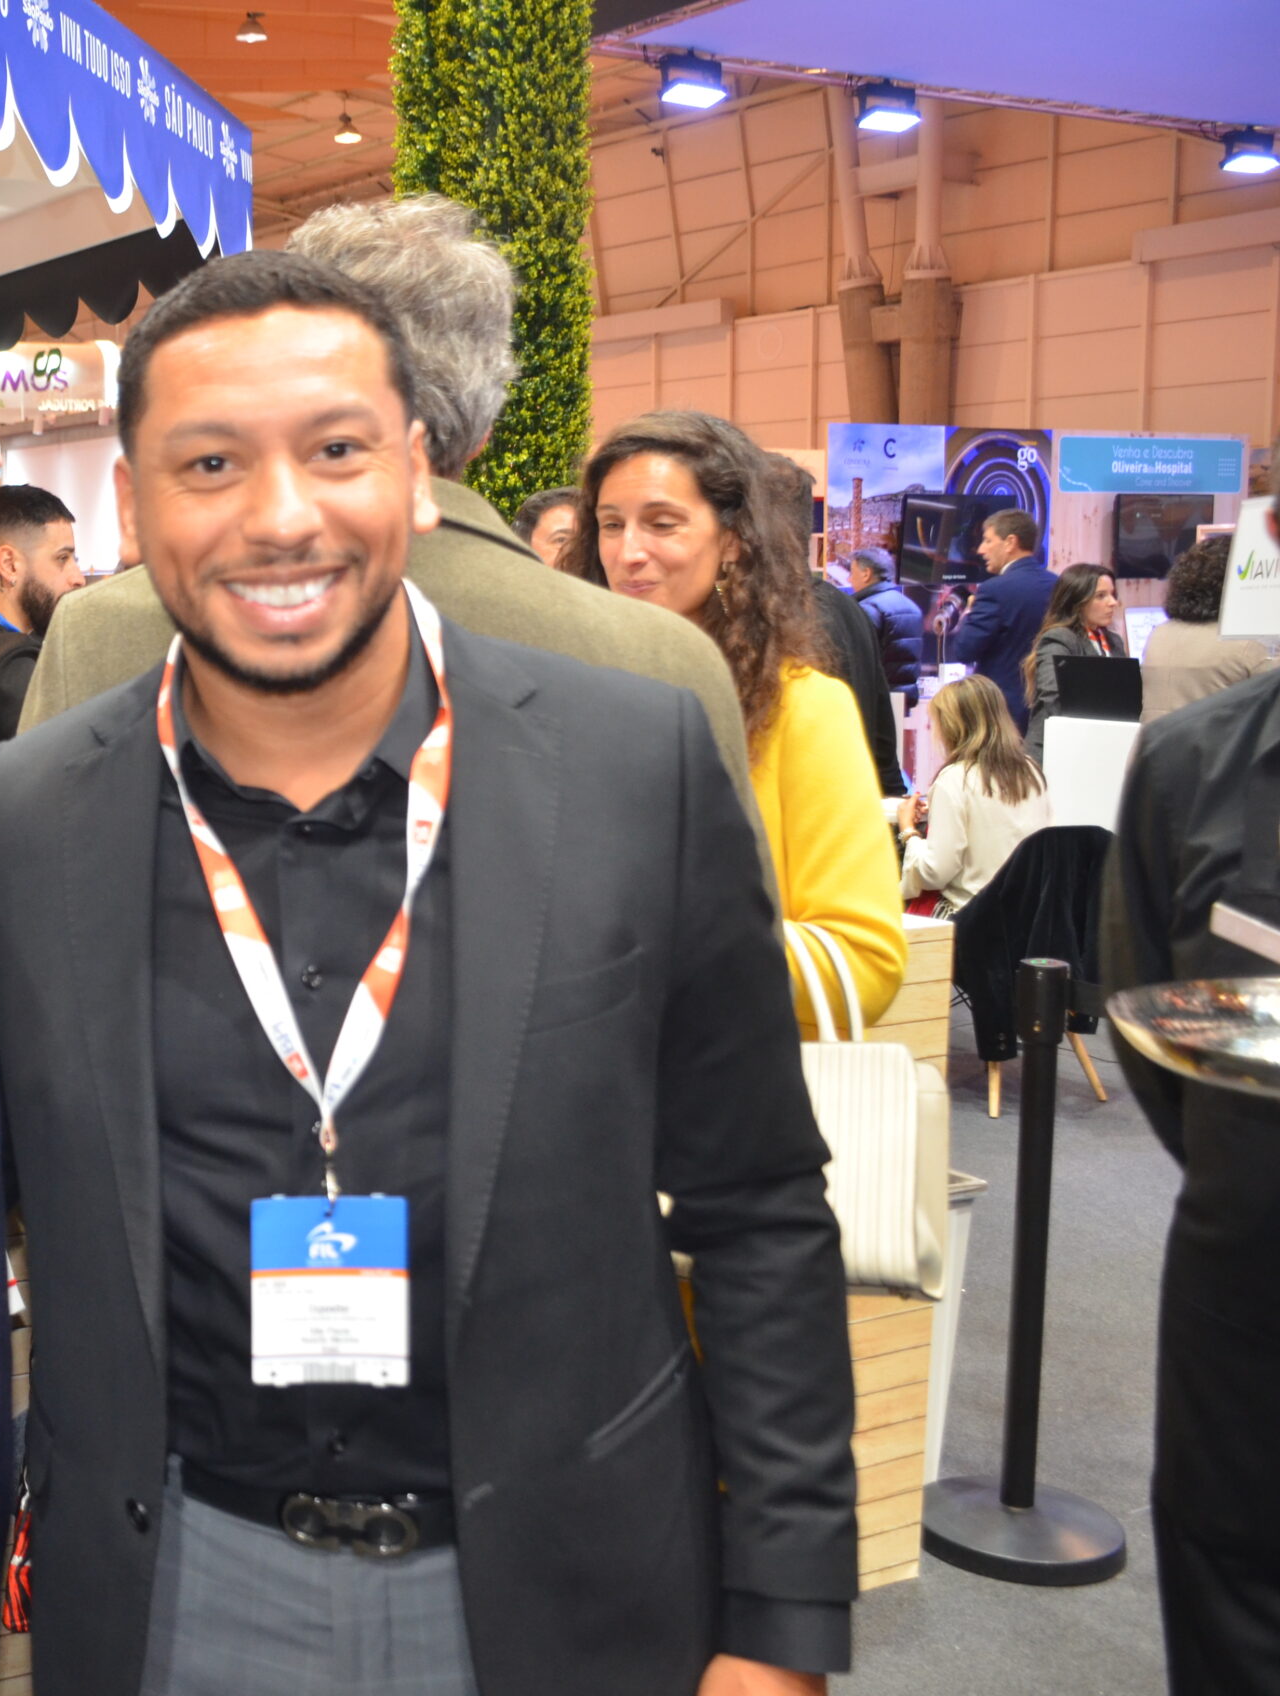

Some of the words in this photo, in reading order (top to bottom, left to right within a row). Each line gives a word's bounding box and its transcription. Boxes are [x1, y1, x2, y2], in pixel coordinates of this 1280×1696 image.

[60, 10, 82, 66] VIVA
[83, 29, 108, 83] TUDO
[110, 49, 131, 99] ISSO
[164, 83, 183, 138] SÃO
[186, 102, 214, 160] PAULO
[1111, 461, 1148, 474] Oliveira
[1155, 461, 1193, 475] Hospital
[1112, 445, 1141, 458] Venha
[1143, 449, 1148, 458] e
[1152, 446, 1193, 459] Descubra
